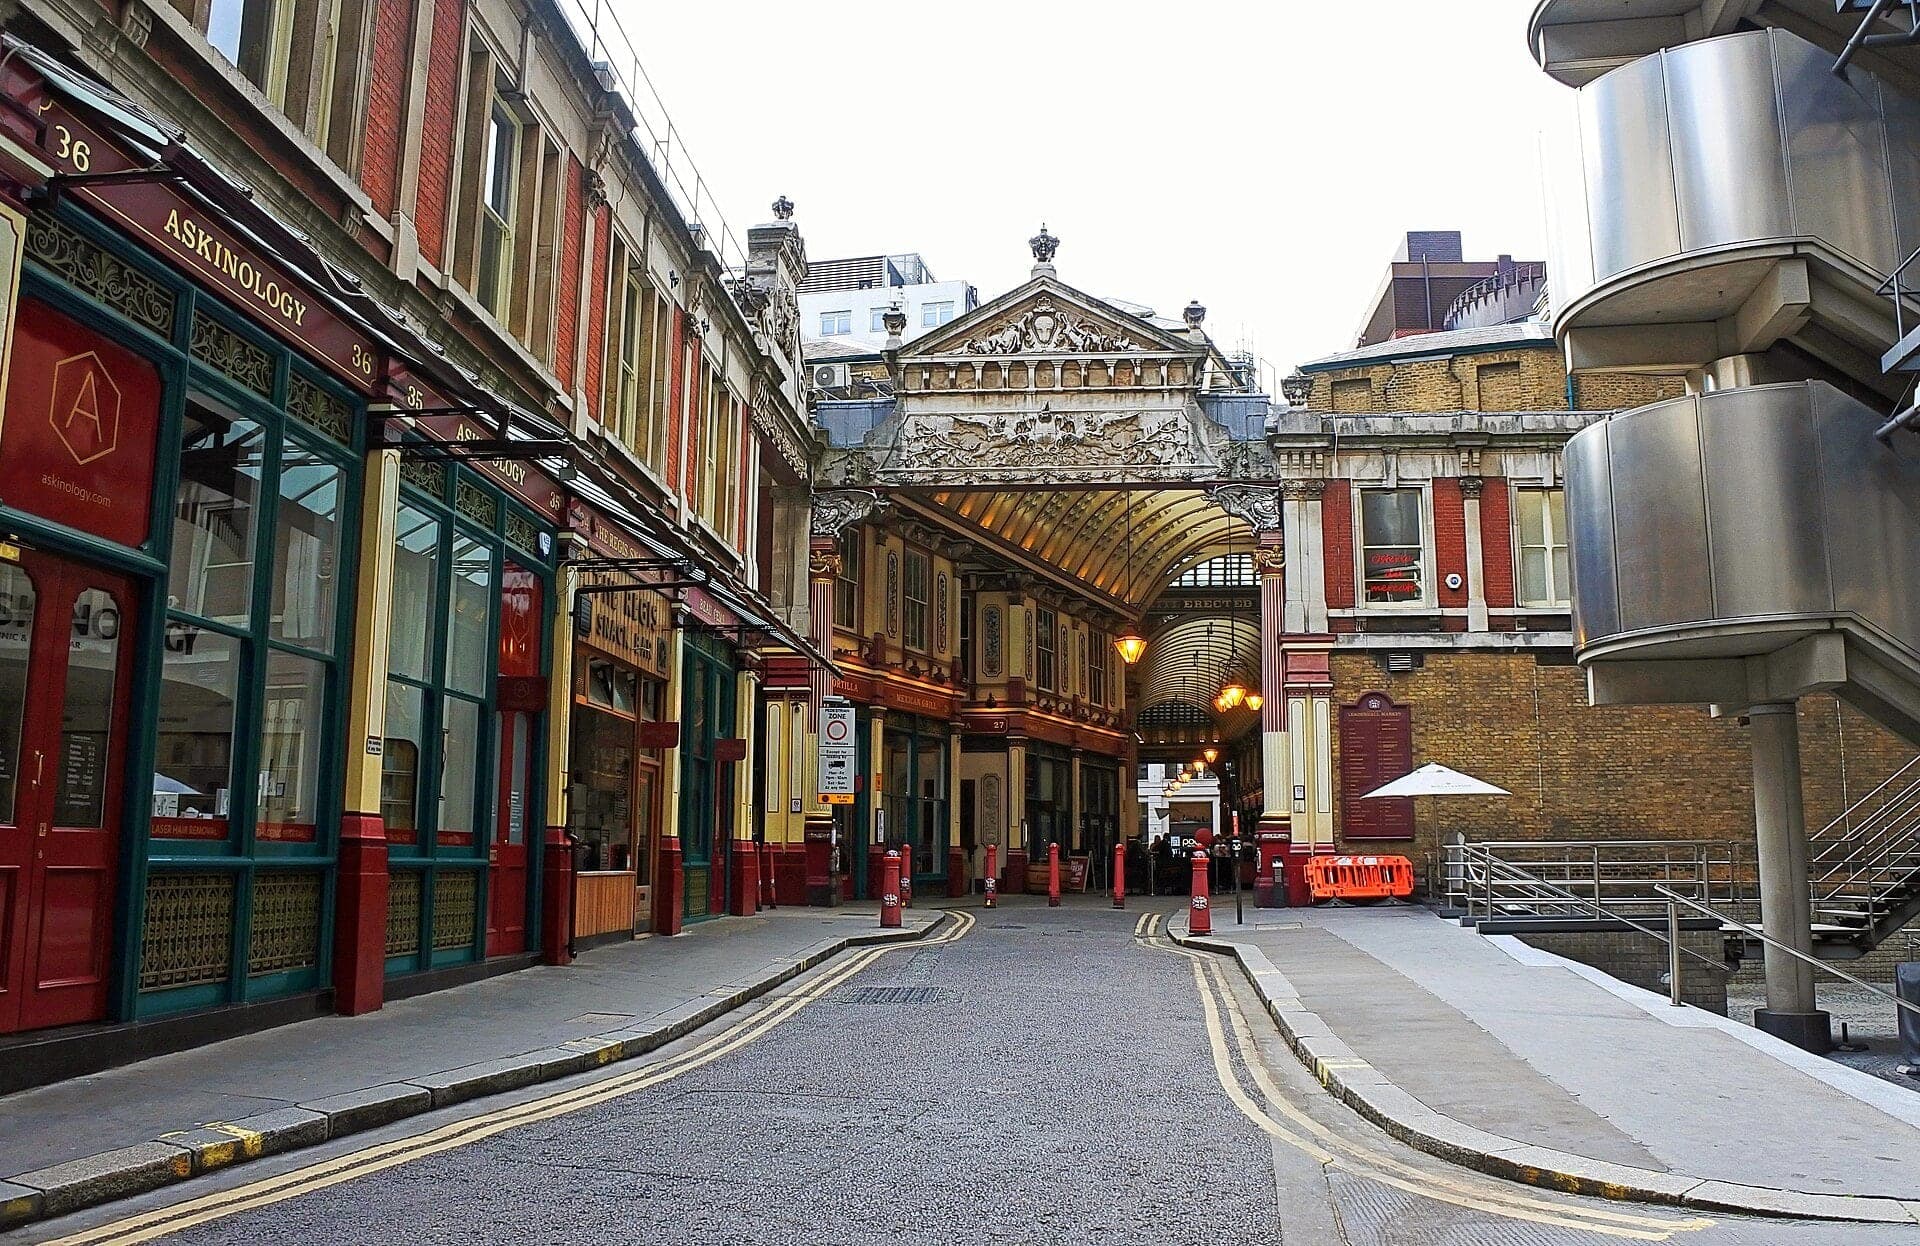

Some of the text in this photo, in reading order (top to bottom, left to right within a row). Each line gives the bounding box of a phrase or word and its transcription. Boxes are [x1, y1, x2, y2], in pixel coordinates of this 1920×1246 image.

[56, 125, 91, 172] 36
[163, 209, 307, 327] ASKINOLOGY
[351, 343, 372, 375] 36
[407, 385, 424, 410] 35
[41, 473, 112, 507] askinology.com
[550, 491, 560, 511] 35
[609, 533, 629, 557] REGIS
[593, 573, 657, 631] THE REGIS
[1183, 600, 1253, 608] ERECTED
[832, 678, 859, 693] ORTILLA
[993, 721, 1005, 729] 27
